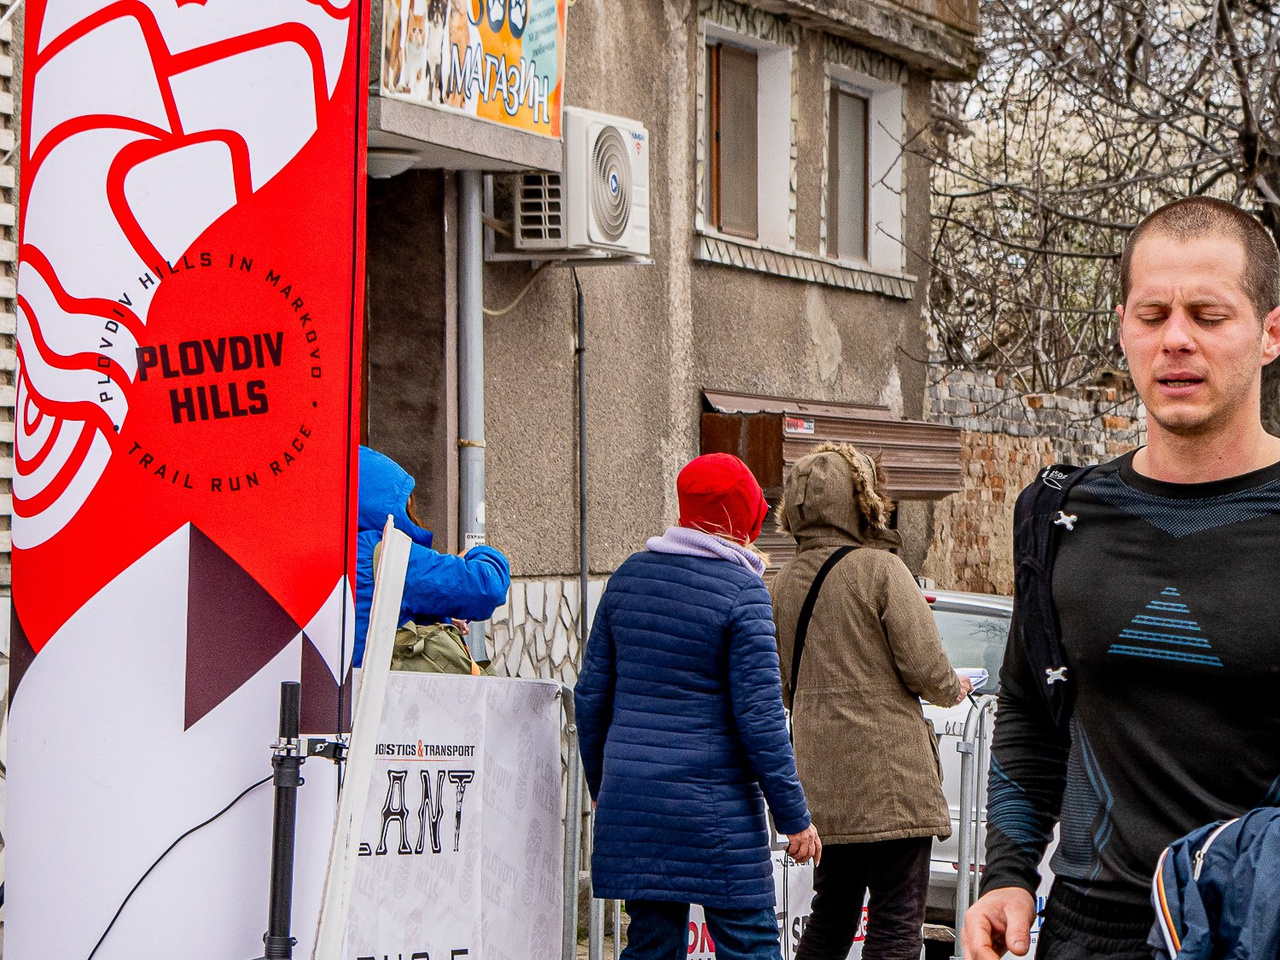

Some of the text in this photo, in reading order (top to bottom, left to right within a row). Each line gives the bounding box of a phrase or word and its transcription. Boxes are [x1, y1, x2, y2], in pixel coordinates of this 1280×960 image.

[450, 43, 550, 124] МАГАЗИН
[97, 252, 322, 403] PLOVDIV HILLS IN MARKOVO
[135, 331, 284, 382] PLOVDIV
[169, 379, 269, 424] HILLS
[128, 424, 312, 493] TRAIL RUN RACE
[358, 769, 475, 857] ANT
